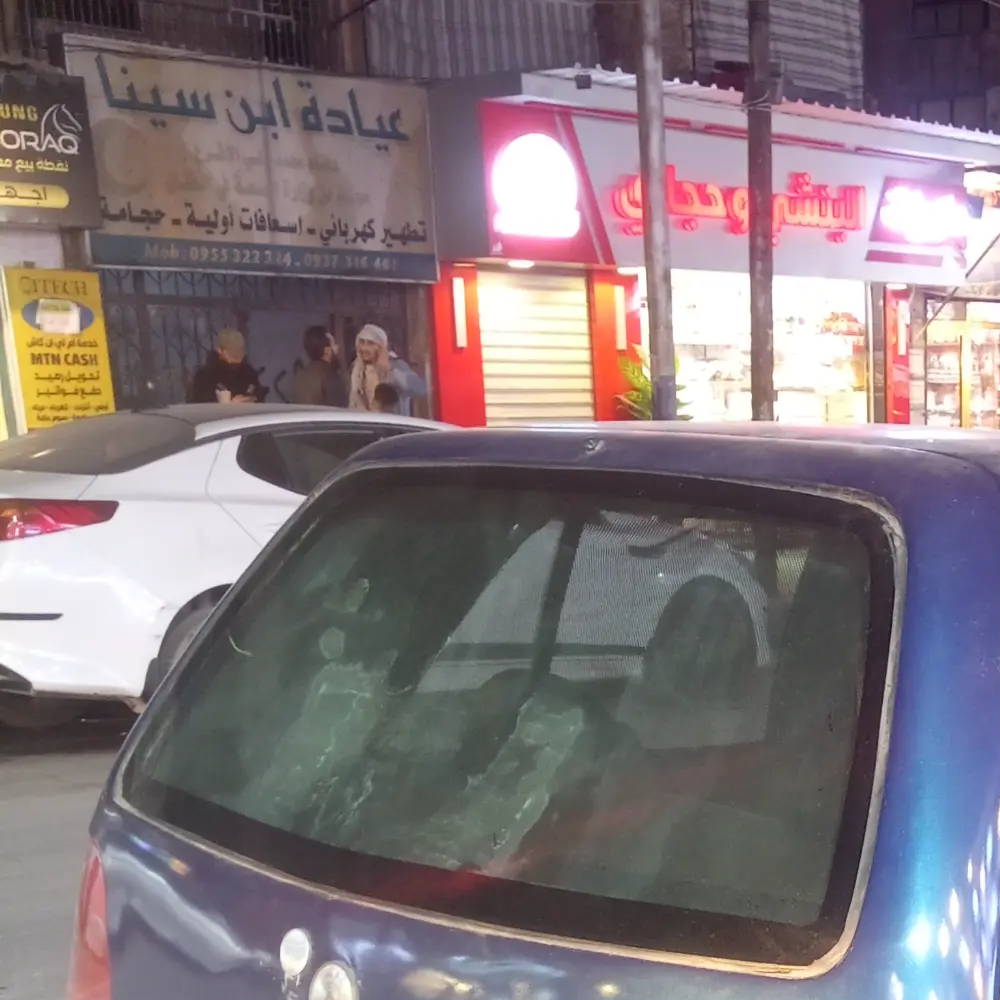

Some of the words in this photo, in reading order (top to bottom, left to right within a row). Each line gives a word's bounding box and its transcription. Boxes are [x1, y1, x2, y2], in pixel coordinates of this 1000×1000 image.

[94, 54, 217, 129] سينا
[225, 77, 292, 141] ابن
[300, 80, 410, 152] عيادة
[184, 201, 235, 235] أولية
[381, 219, 428, 248] تطهير
[189, 245, 228, 261] 0955
[232, 248, 260, 263] 322
[31, 353, 61, 366] MTN
[64, 353, 99, 366] CASH
